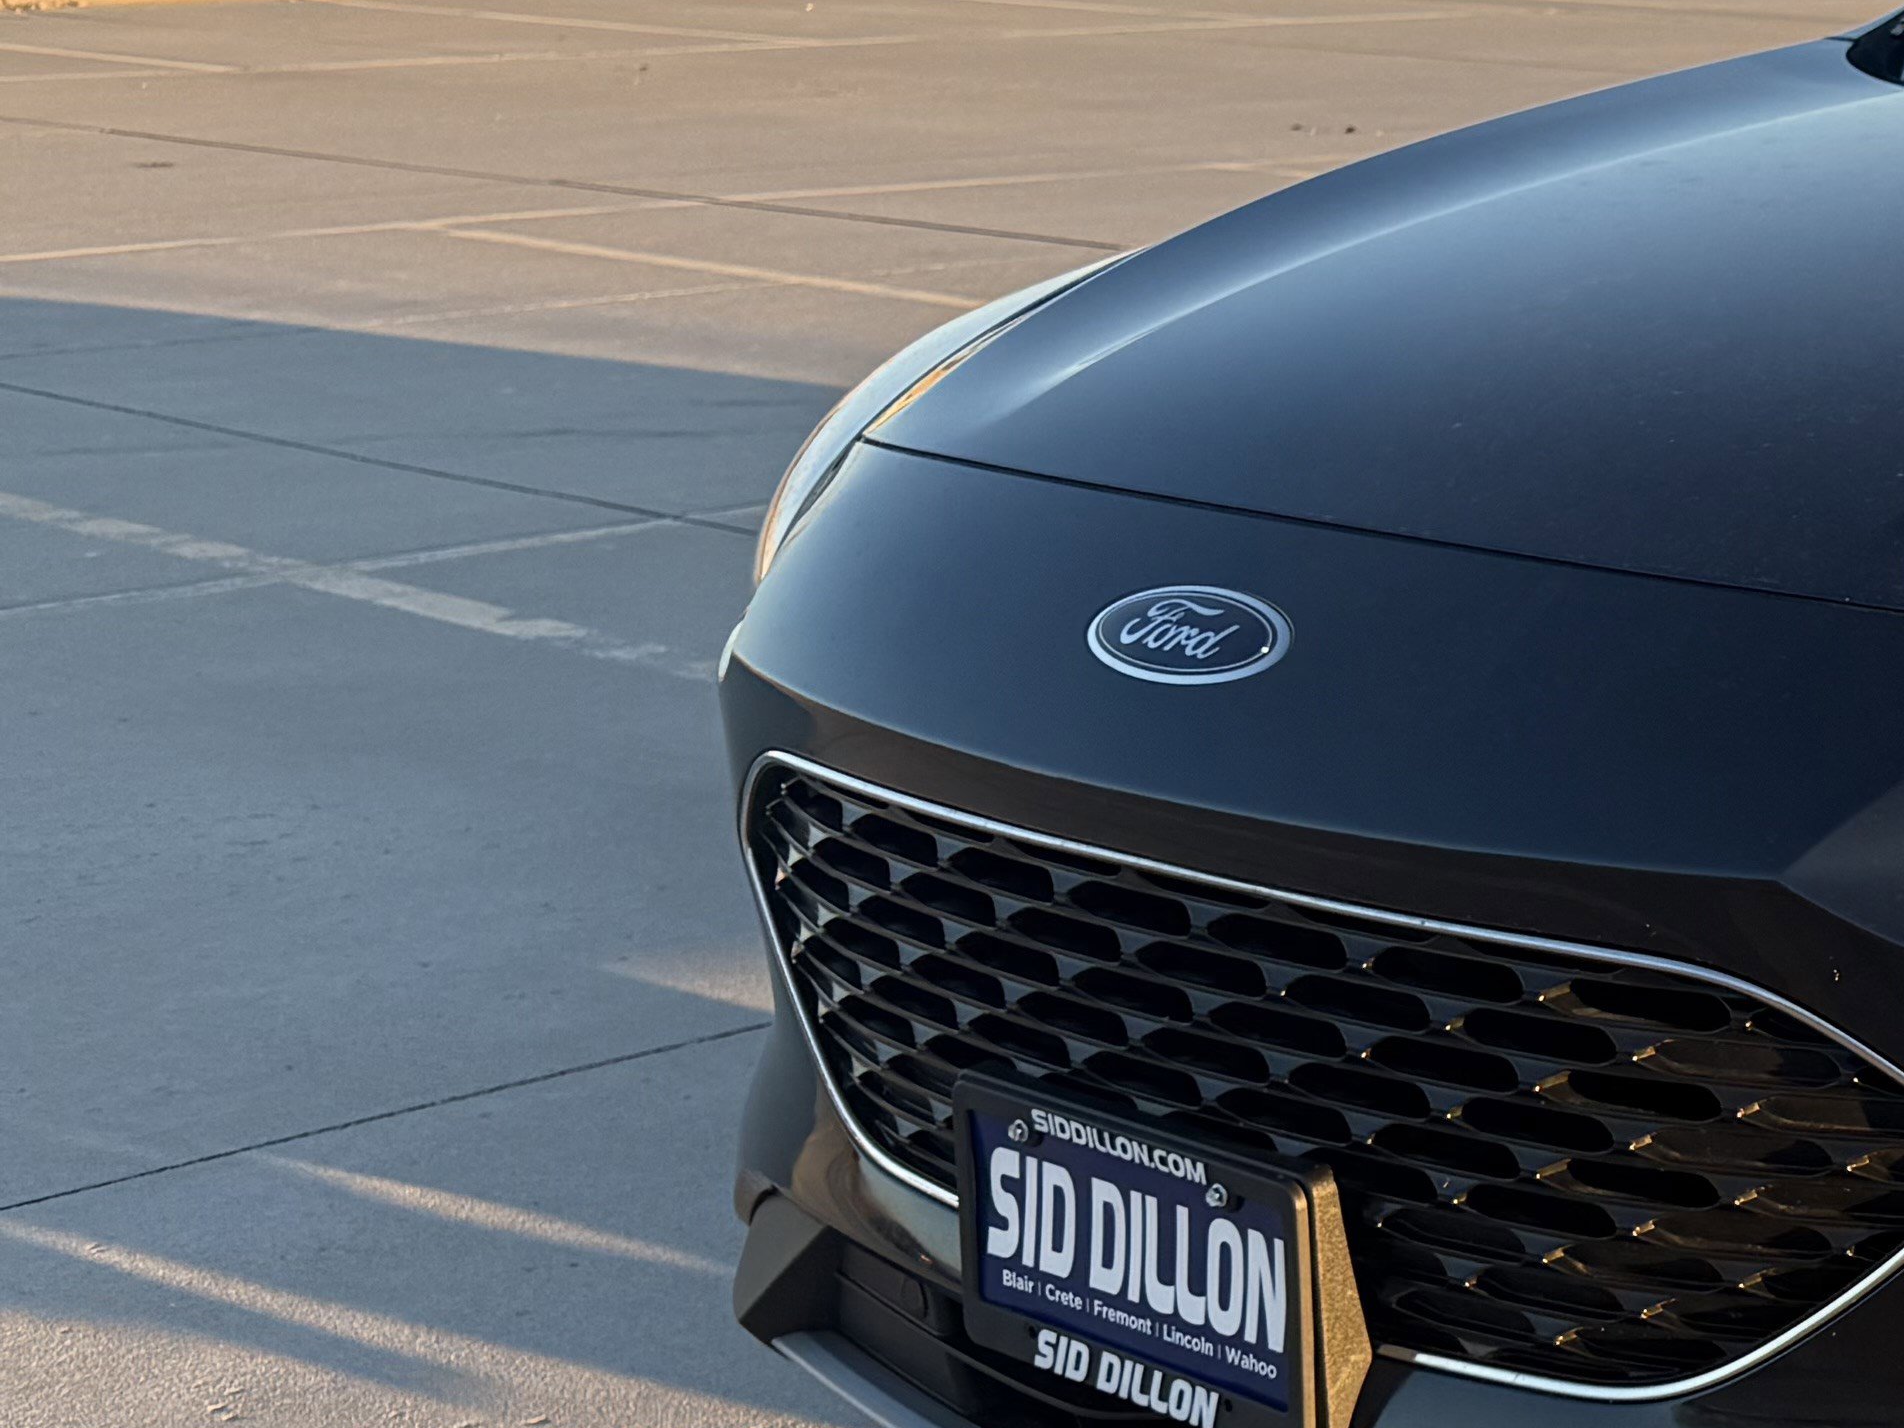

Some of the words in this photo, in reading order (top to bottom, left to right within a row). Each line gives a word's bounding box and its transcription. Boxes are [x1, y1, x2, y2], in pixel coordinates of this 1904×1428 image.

[1119, 598, 1241, 660] Ford
[1031, 1108, 1208, 1186] SIDDILLON.COM
[986, 1146, 1077, 1279] SID
[1088, 1176, 1288, 1354] DILLON
[1001, 1269, 1035, 1295] Blair
[1045, 1284, 1083, 1312] Crete
[1093, 1300, 1153, 1337] Fremont
[1162, 1324, 1214, 1358] Lincoln
[1225, 1344, 1278, 1381] Wahoo
[1033, 1329, 1090, 1383] SID
